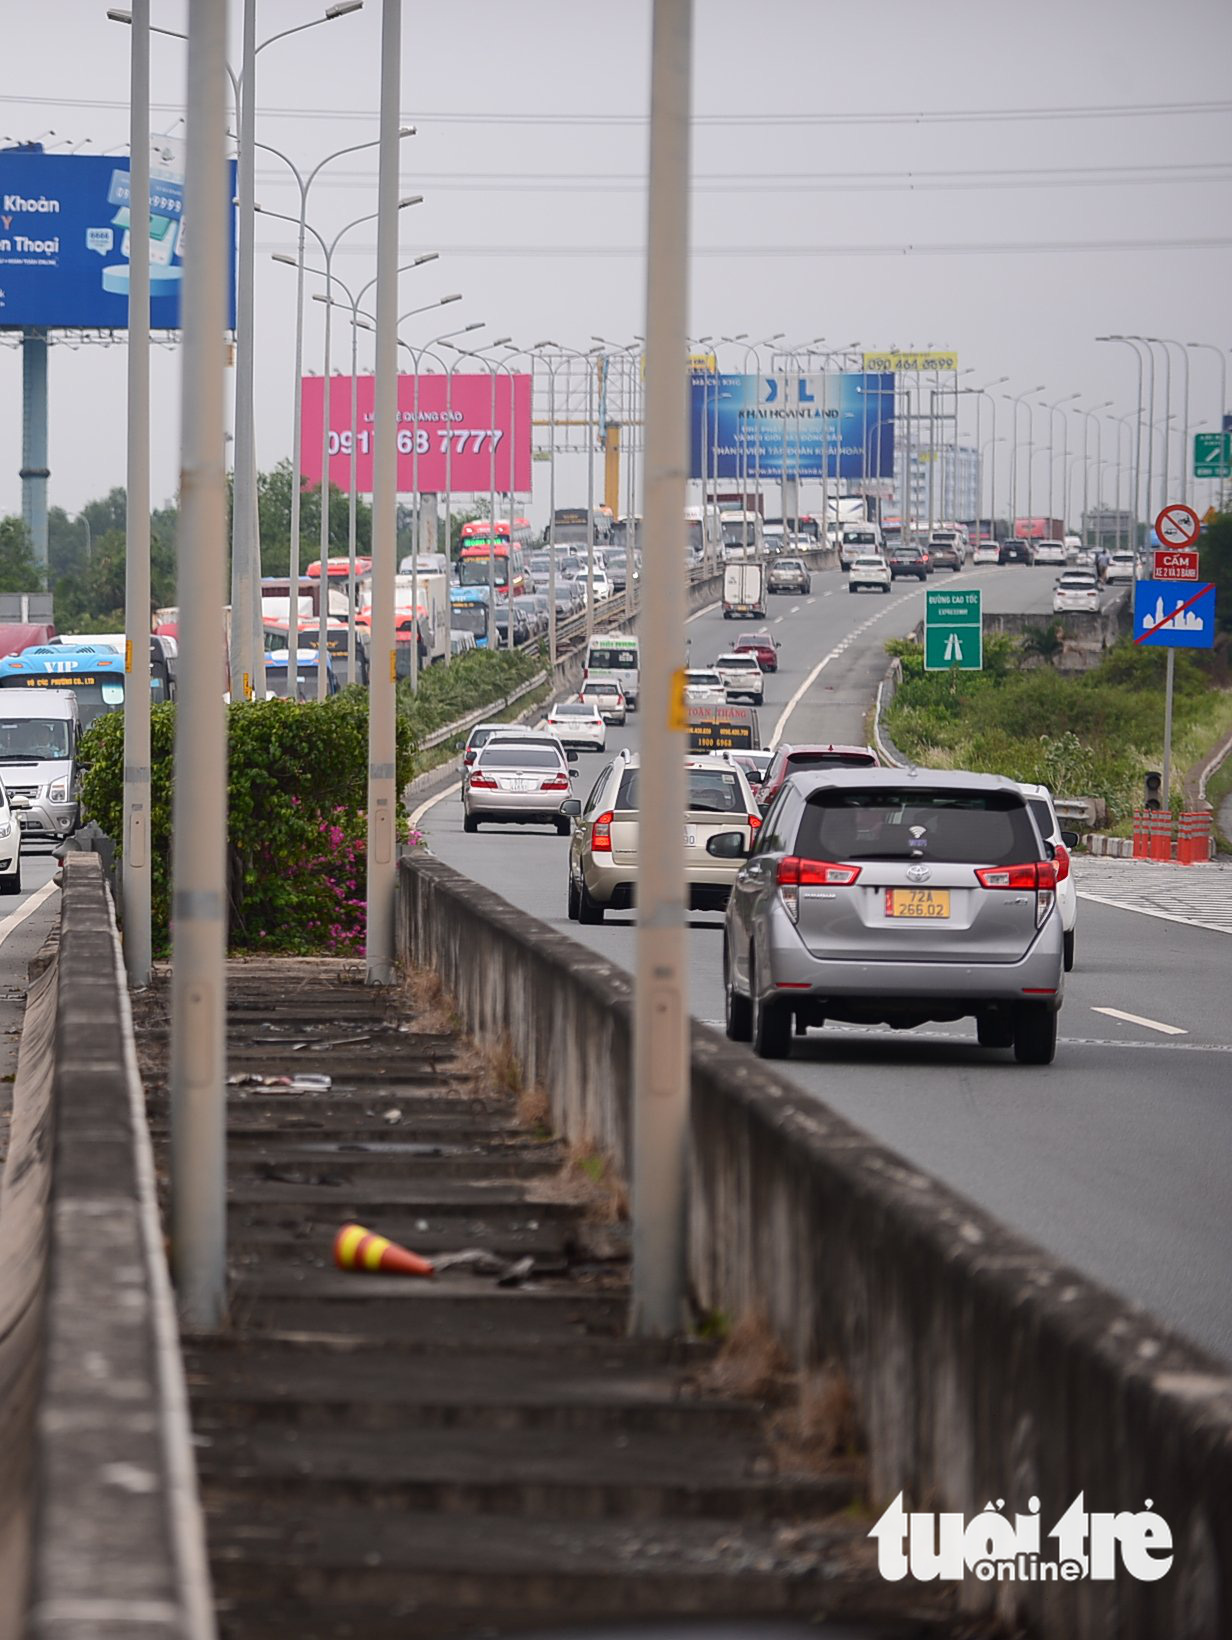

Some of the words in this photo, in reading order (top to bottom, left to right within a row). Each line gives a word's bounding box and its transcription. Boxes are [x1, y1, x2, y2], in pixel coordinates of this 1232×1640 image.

[14, 235, 60, 256] Thoại
[1163, 553, 1190, 566] CẤM
[44, 661, 79, 674] VIP
[909, 889, 934, 903] 72A
[899, 903, 945, 916] 266.02
